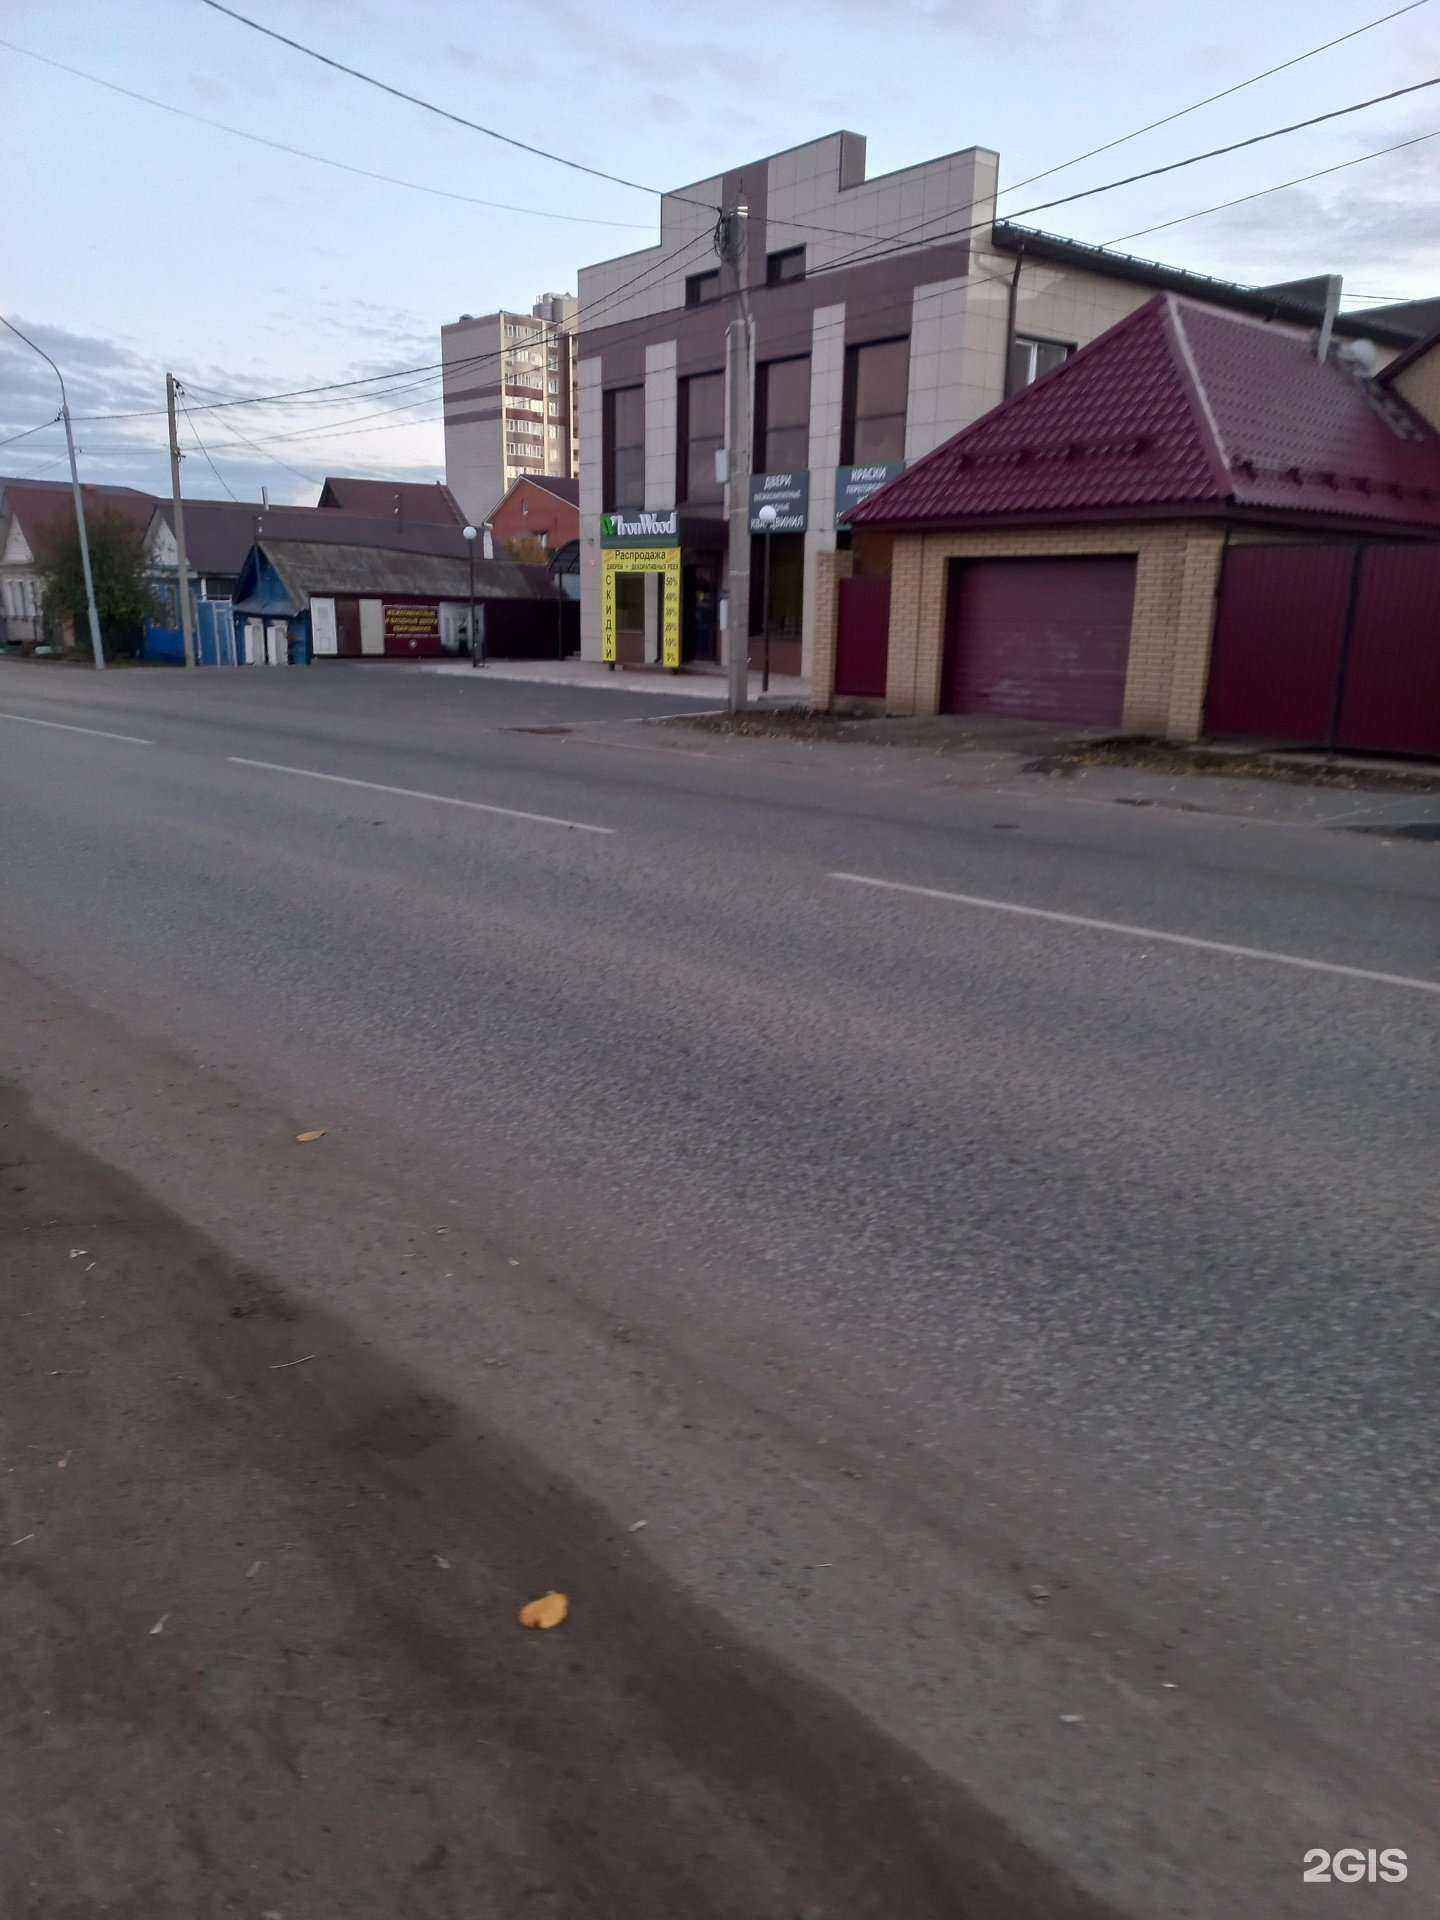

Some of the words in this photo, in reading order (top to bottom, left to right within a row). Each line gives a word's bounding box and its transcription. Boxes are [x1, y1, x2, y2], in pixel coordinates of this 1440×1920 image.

[763, 474, 793, 490] ДВЕРИ
[614, 512, 678, 536] IronWood
[615, 550, 666, 562] Распродажа
